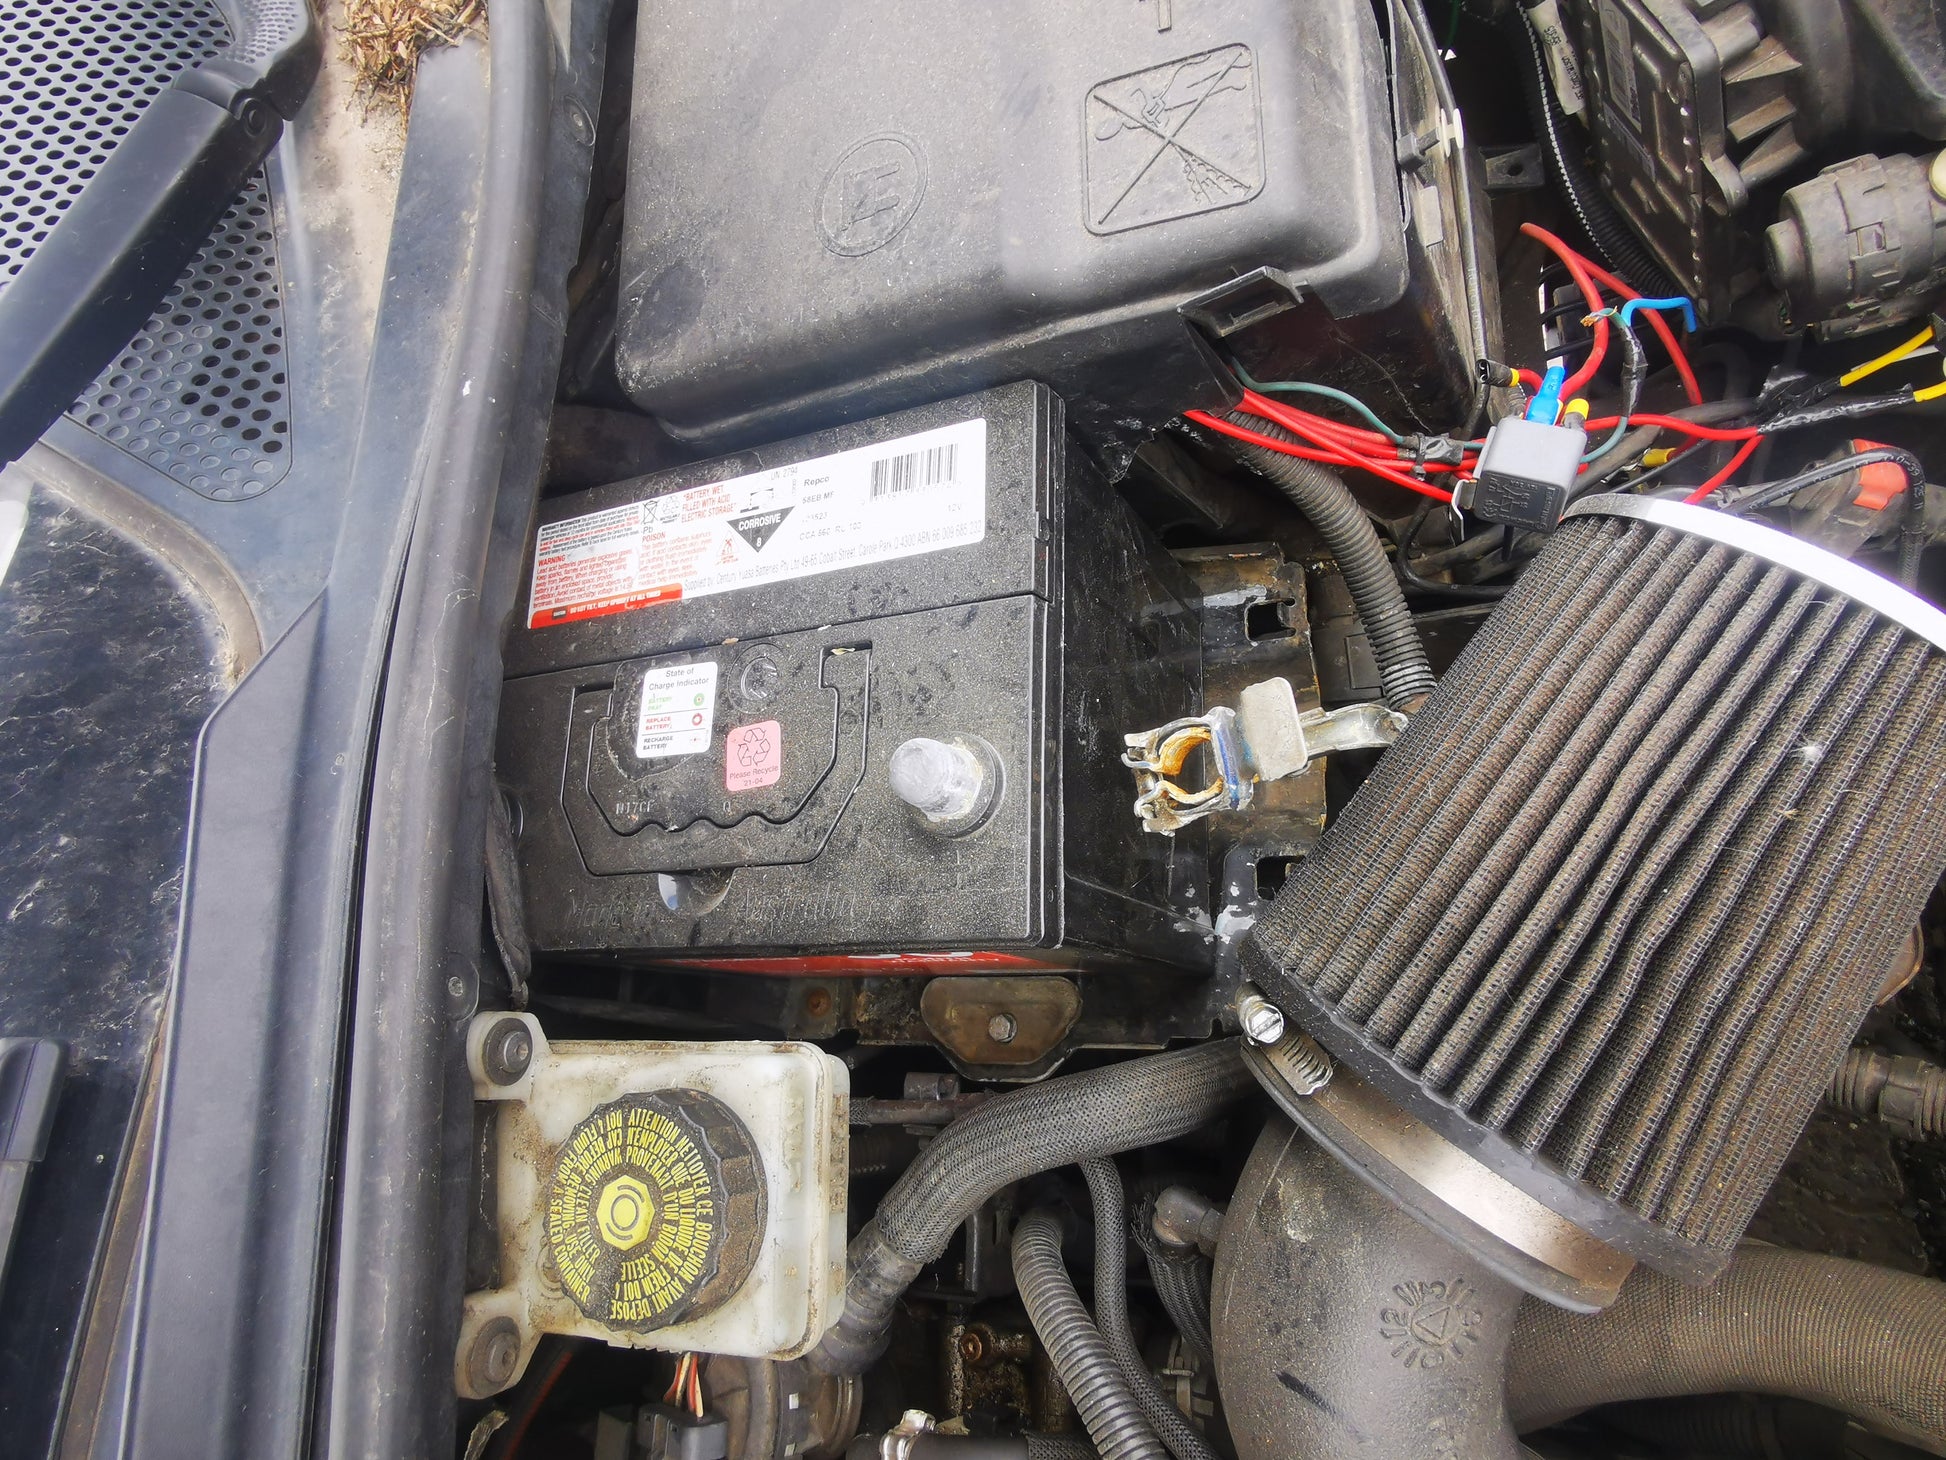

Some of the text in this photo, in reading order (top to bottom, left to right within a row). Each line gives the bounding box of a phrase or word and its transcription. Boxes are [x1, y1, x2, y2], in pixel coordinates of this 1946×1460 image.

[804, 476, 830, 487] Repco
[682, 494, 731, 512] FILLED WITH ACID
[681, 510, 707, 524] ELECTRIC
[738, 513, 782, 530] CORROSIVE
[642, 531, 665, 542] POISON
[756, 537, 762, 547] 8
[538, 554, 565, 566] WARNING
[684, 576, 706, 590] Supplied
[716, 570, 737, 584] Century
[755, 562, 779, 576] Batteries
[780, 559, 789, 571] Pty
[879, 539, 891, 552] Park
[917, 531, 930, 544] ABN
[666, 668, 694, 678] State of
[649, 677, 709, 692] Charge Indicator
[645, 723, 670, 731] BATTERY
[646, 716, 671, 724] REPLACE
[643, 743, 668, 751] BATTERY
[644, 735, 674, 744] RECHARGE
[730, 765, 779, 780] Please Recycle
[744, 777, 763, 786] 21-04
[606, 1127, 622, 1150] CAP
[574, 1137, 606, 1174] BEFORE
[670, 1162, 691, 1188] QUE
[678, 1187, 696, 1206] DU
[550, 1110, 622, 1303] DOT 4 FLUID FROM A SEALED CONTAINER
[575, 1148, 622, 1264] WARNING CLEAN FILLER
[610, 1108, 714, 1321] ATTENTION NETTOYER CE BOUCHON AVANT DEPOSE
[620, 1148, 680, 1282] PROVENANT D'UN BIDON SCELLE
[675, 1206, 697, 1255] LIQUIDE
[565, 1234, 582, 1259] USE
[574, 1255, 596, 1284] ONLY
[664, 1250, 684, 1274] DE
[641, 1265, 672, 1296] FREIN
[614, 1282, 620, 1300] 4
[623, 1281, 642, 1301] DOT
